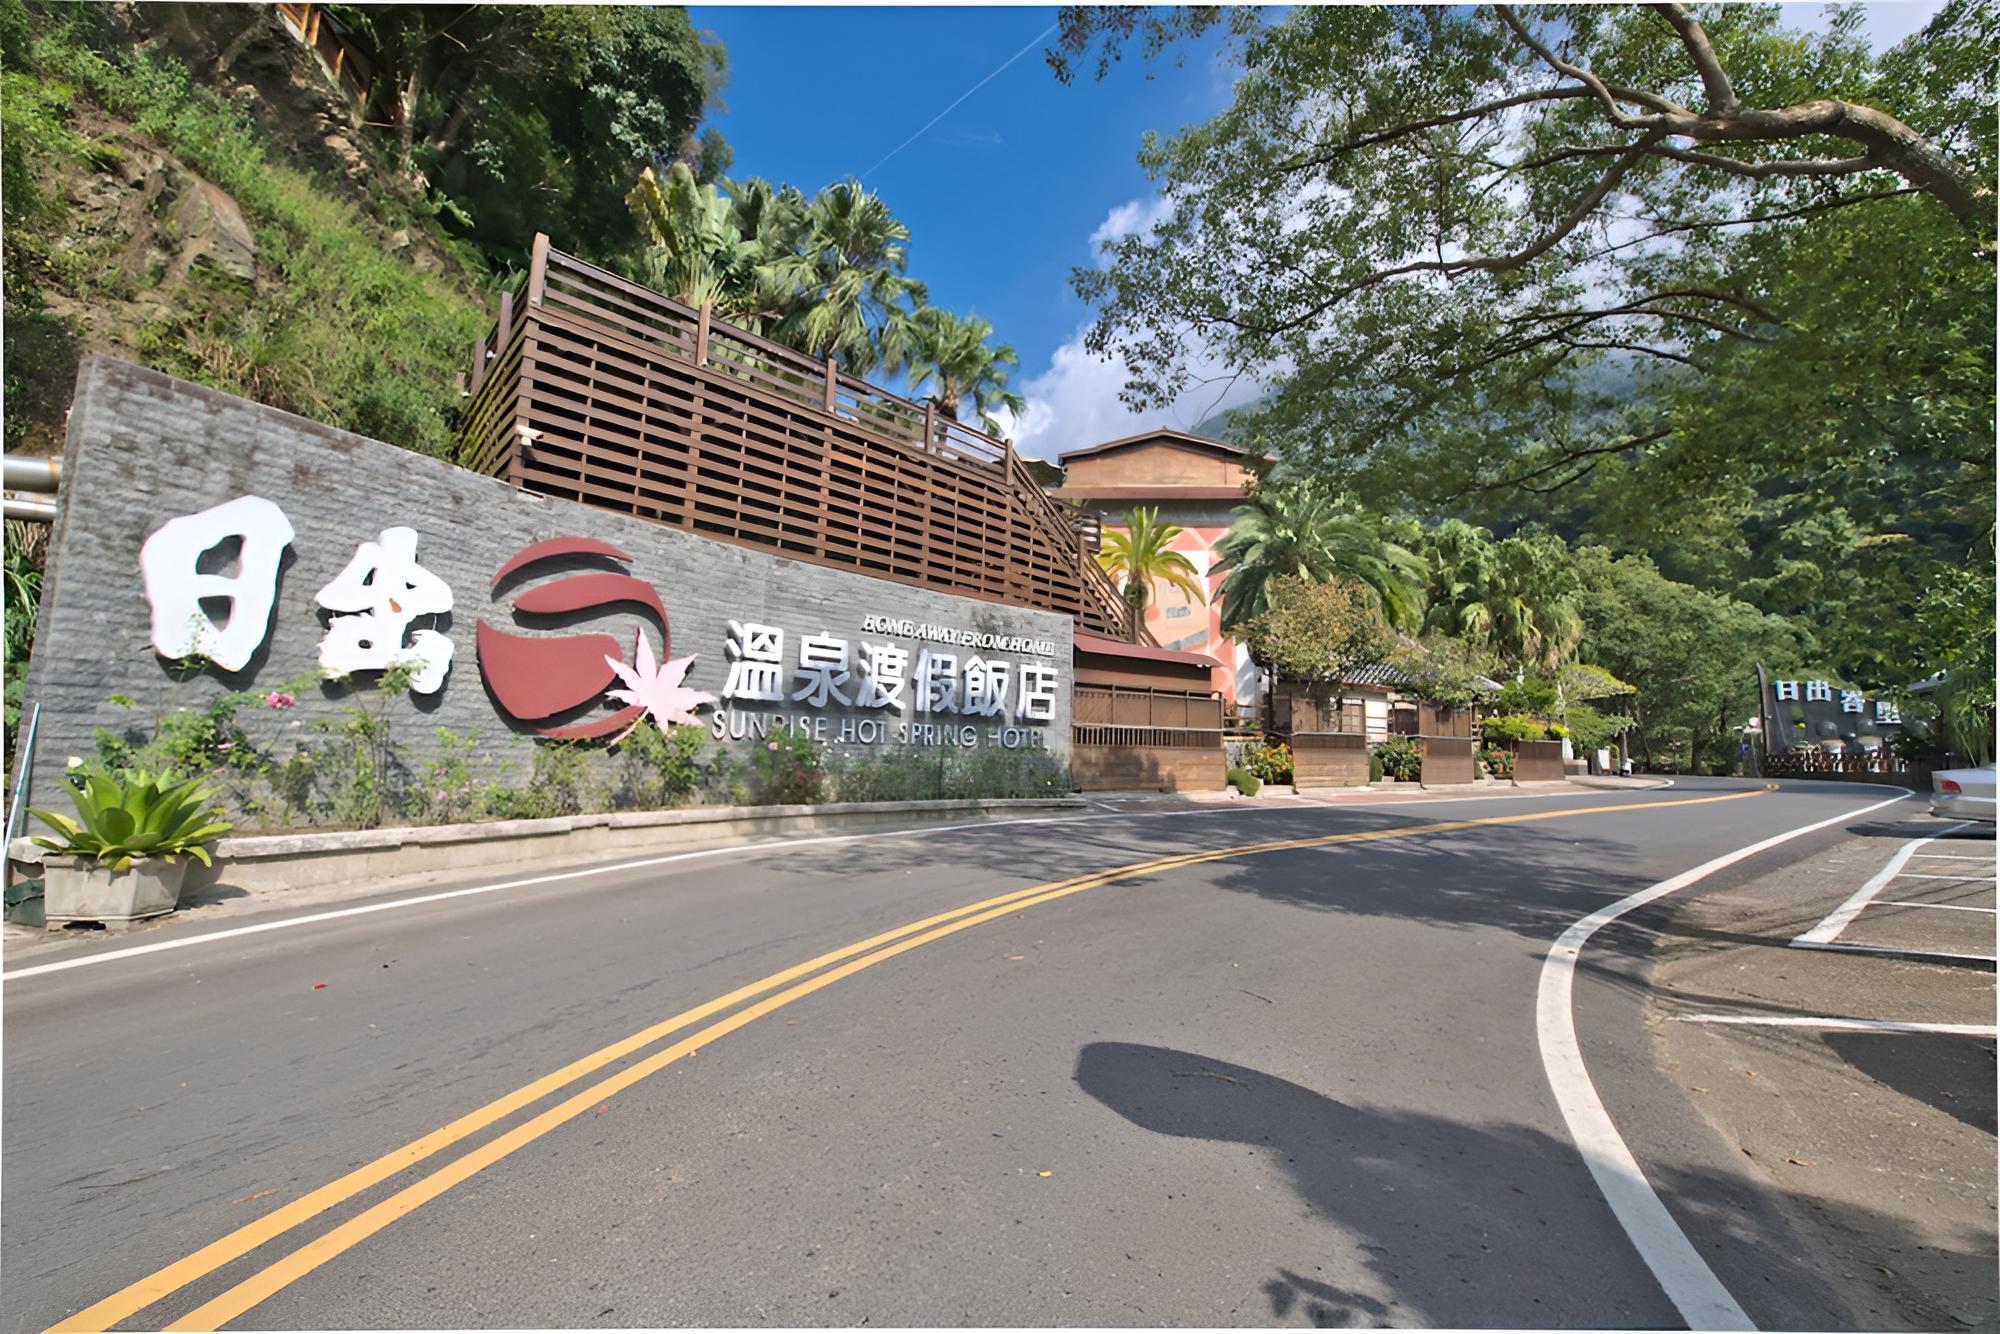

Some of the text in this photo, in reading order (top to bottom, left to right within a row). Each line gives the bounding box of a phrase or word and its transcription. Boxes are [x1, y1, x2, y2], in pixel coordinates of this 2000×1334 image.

[862, 614, 914, 635] HOME
[914, 623, 960, 645] AWAY
[960, 631, 1010, 652] FROM
[722, 619, 1057, 720] 溫泉渡假飯店
[841, 717, 888, 744] HOT
[898, 722, 978, 747] SPRING
